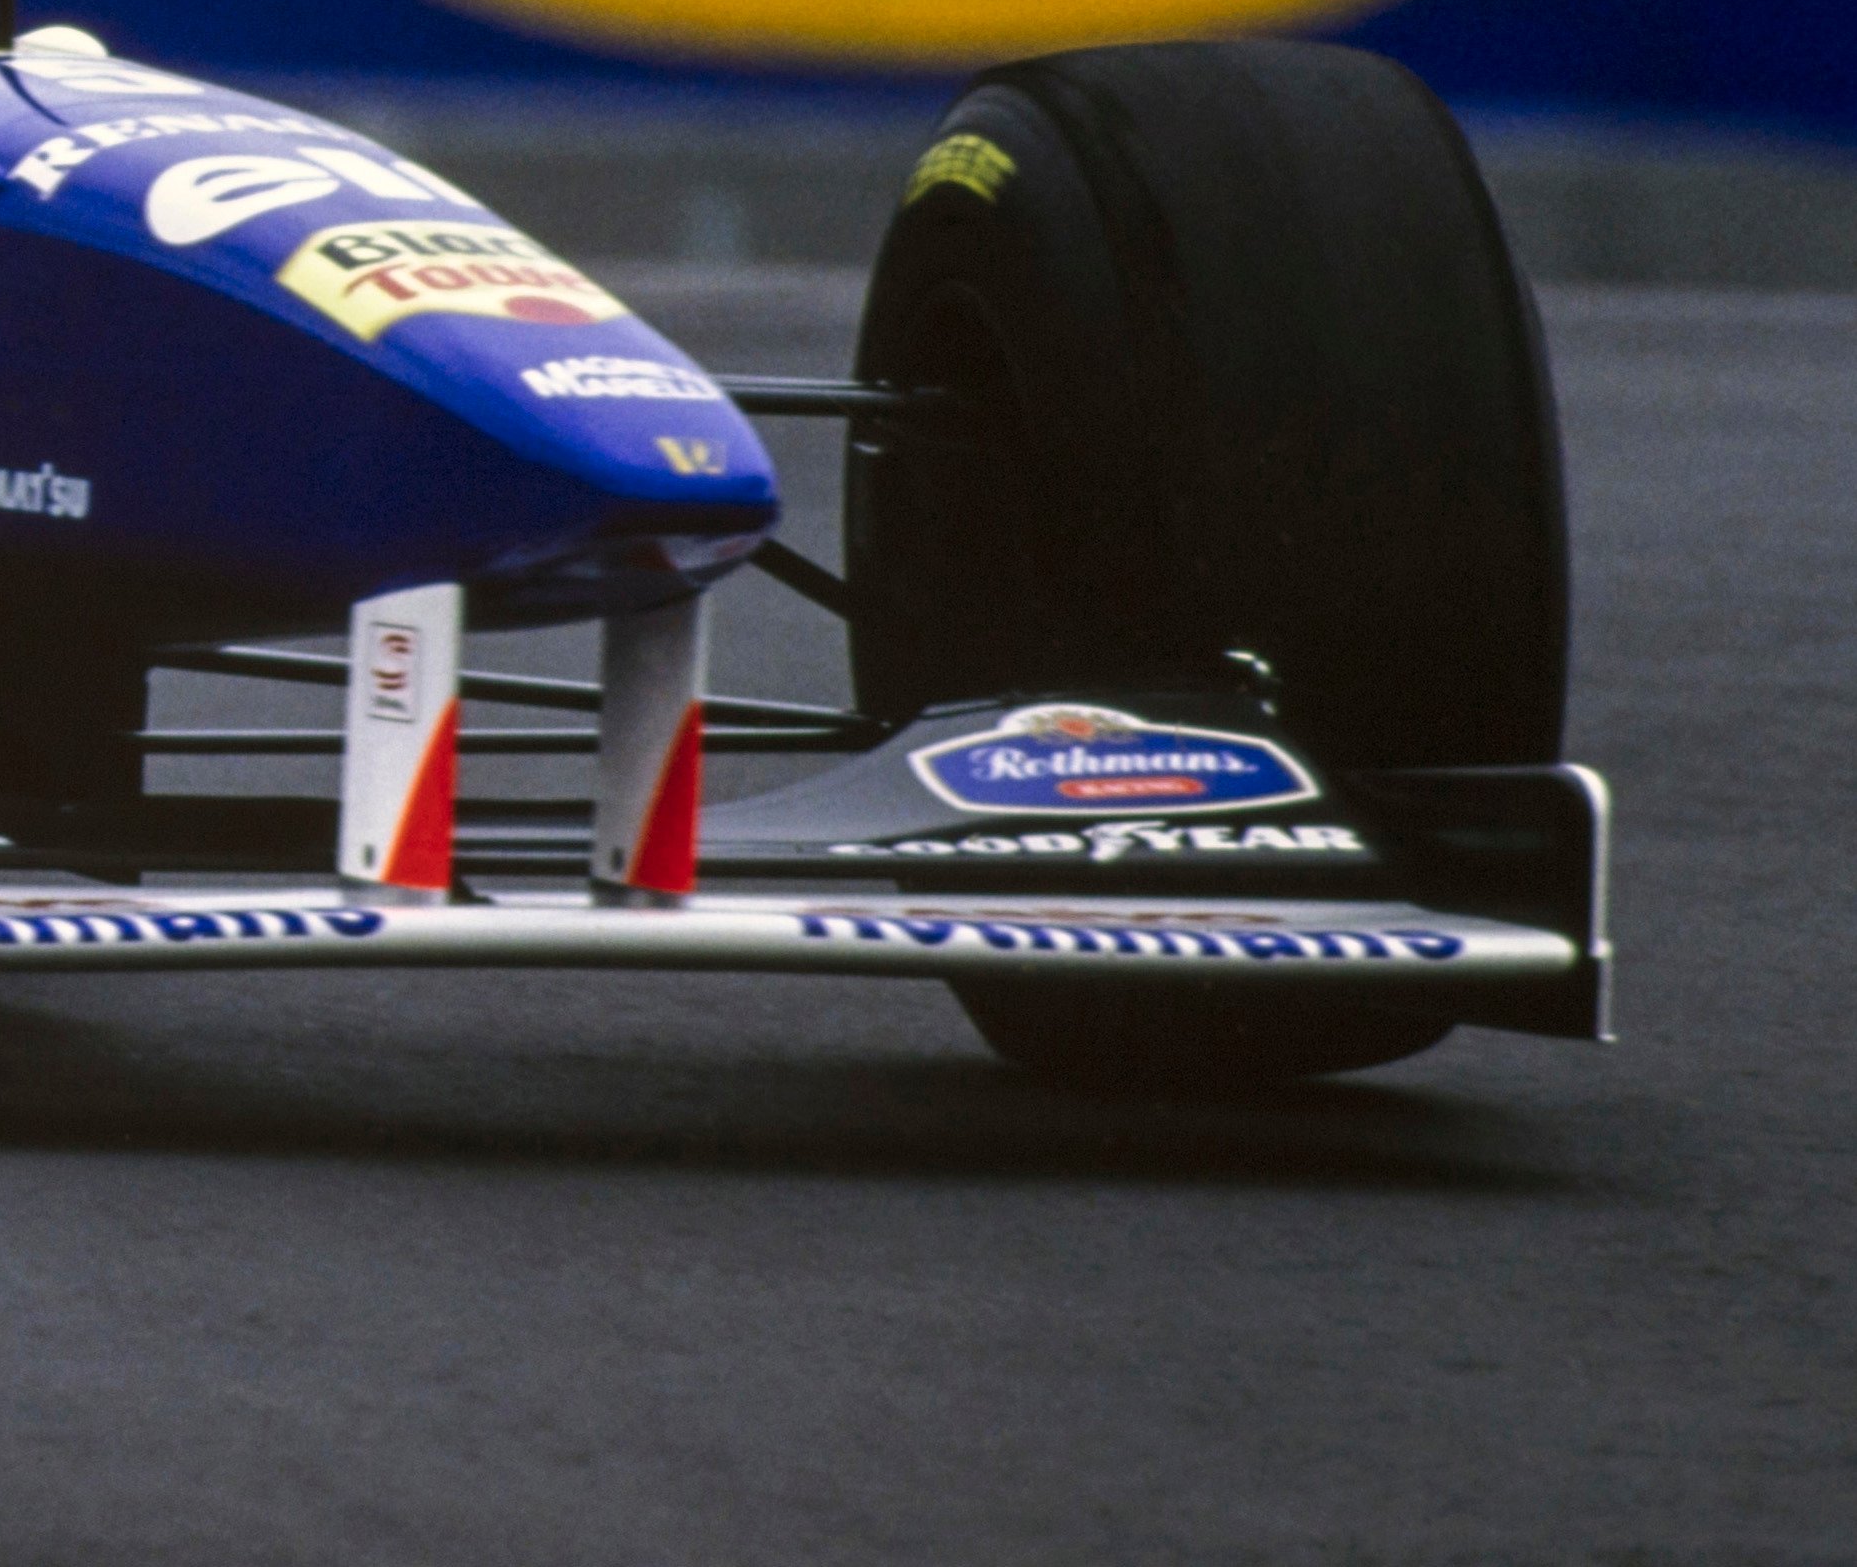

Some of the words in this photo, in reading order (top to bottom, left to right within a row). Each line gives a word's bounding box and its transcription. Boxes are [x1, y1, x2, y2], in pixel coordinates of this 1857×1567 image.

[317, 230, 560, 271] Blac
[343, 263, 607, 302] Towe
[969, 744, 1259, 780] Rothmans
[828, 821, 1365, 862] GOODYEAR
